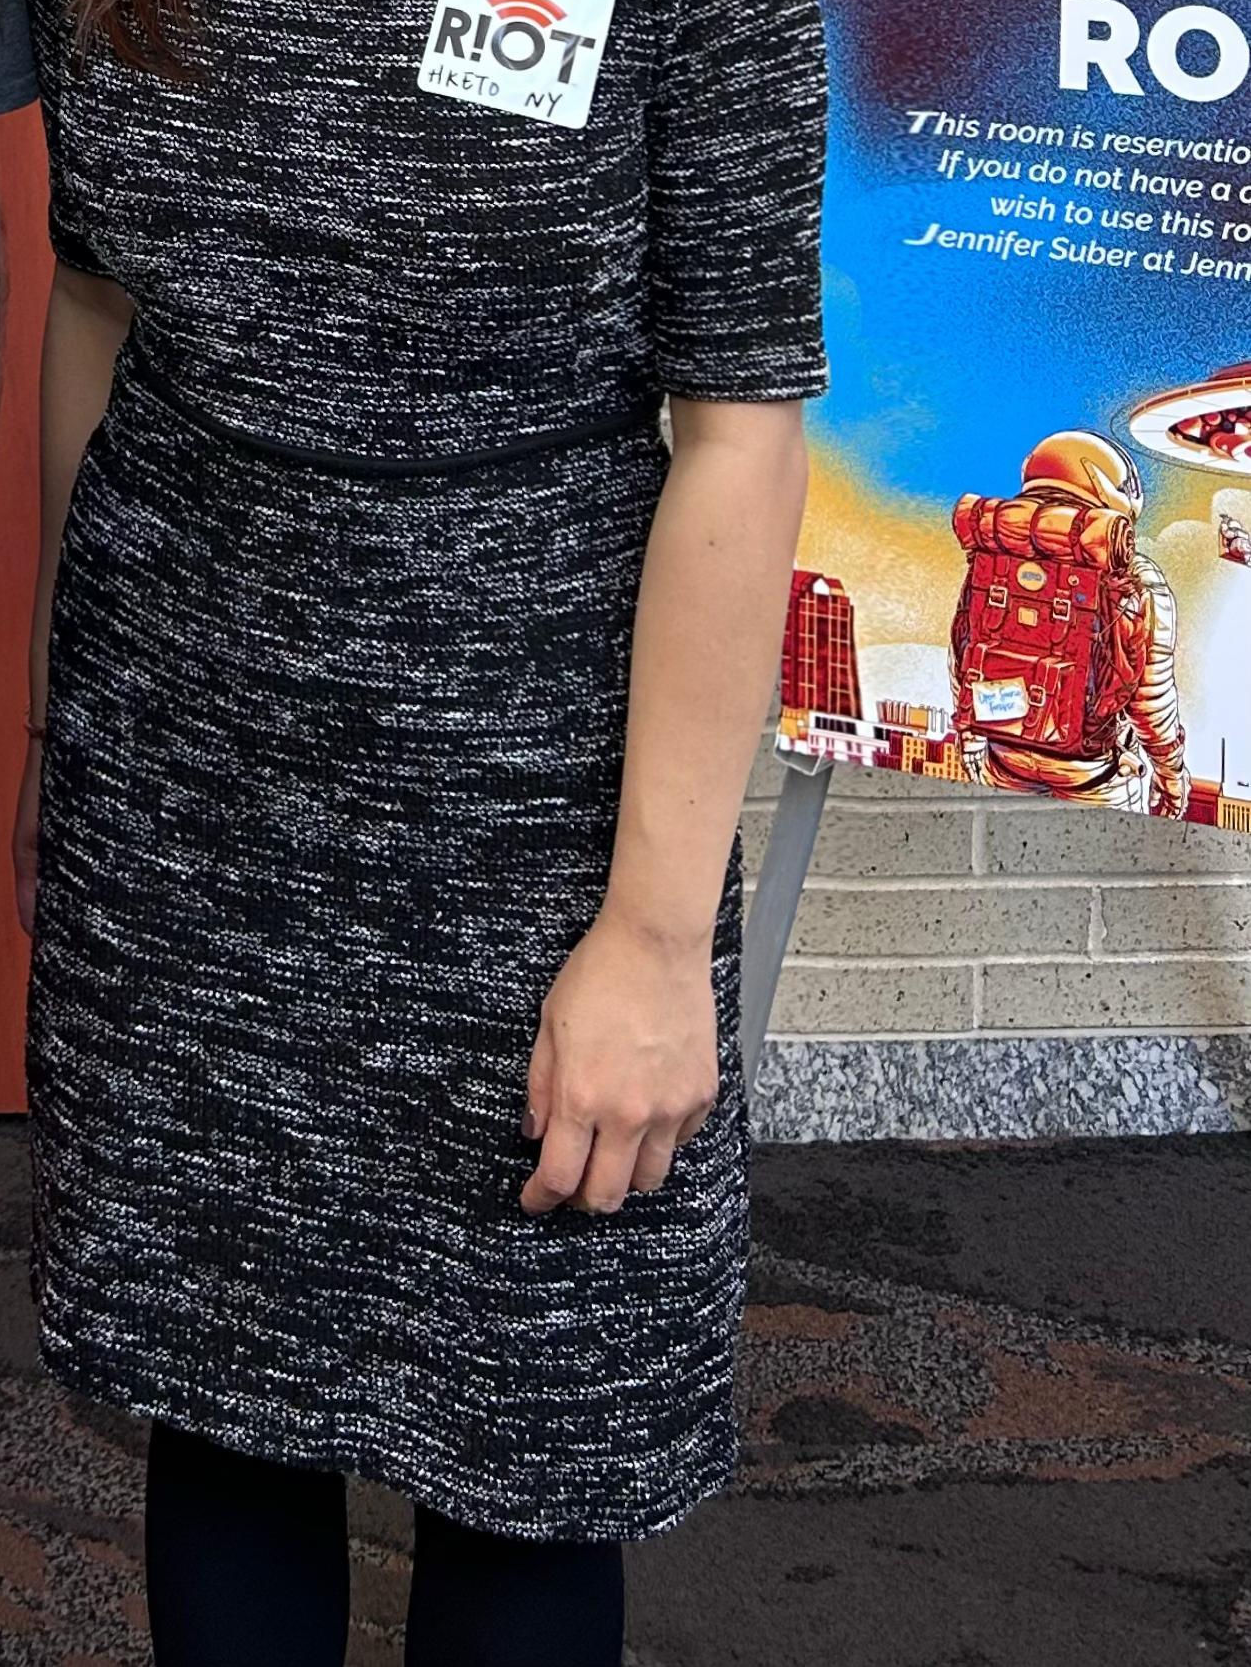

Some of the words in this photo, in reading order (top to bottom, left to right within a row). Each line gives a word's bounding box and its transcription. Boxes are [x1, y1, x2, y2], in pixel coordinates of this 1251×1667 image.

[525, 92, 563, 118] NY
[905, 110, 981, 138] This
[986, 121, 1065, 147] room
[1071, 124, 1096, 150] is
[1102, 133, 1251, 164] reservatio
[937, 149, 964, 179] If
[964, 157, 1021, 181] you
[1029, 160, 1067, 184] do
[1074, 167, 1124, 191] not
[1130, 168, 1204, 198] have
[1211, 182, 1231, 201] a
[990, 194, 1056, 222] wish
[1064, 201, 1093, 225] to
[1101, 209, 1154, 232] use
[1161, 210, 1215, 239] this
[1221, 221, 1251, 242] ro
[903, 223, 1045, 261] Jennifer
[1049, 236, 1138, 268] Suber
[1143, 249, 1176, 273] at
[1180, 251, 1251, 282] Jenn
